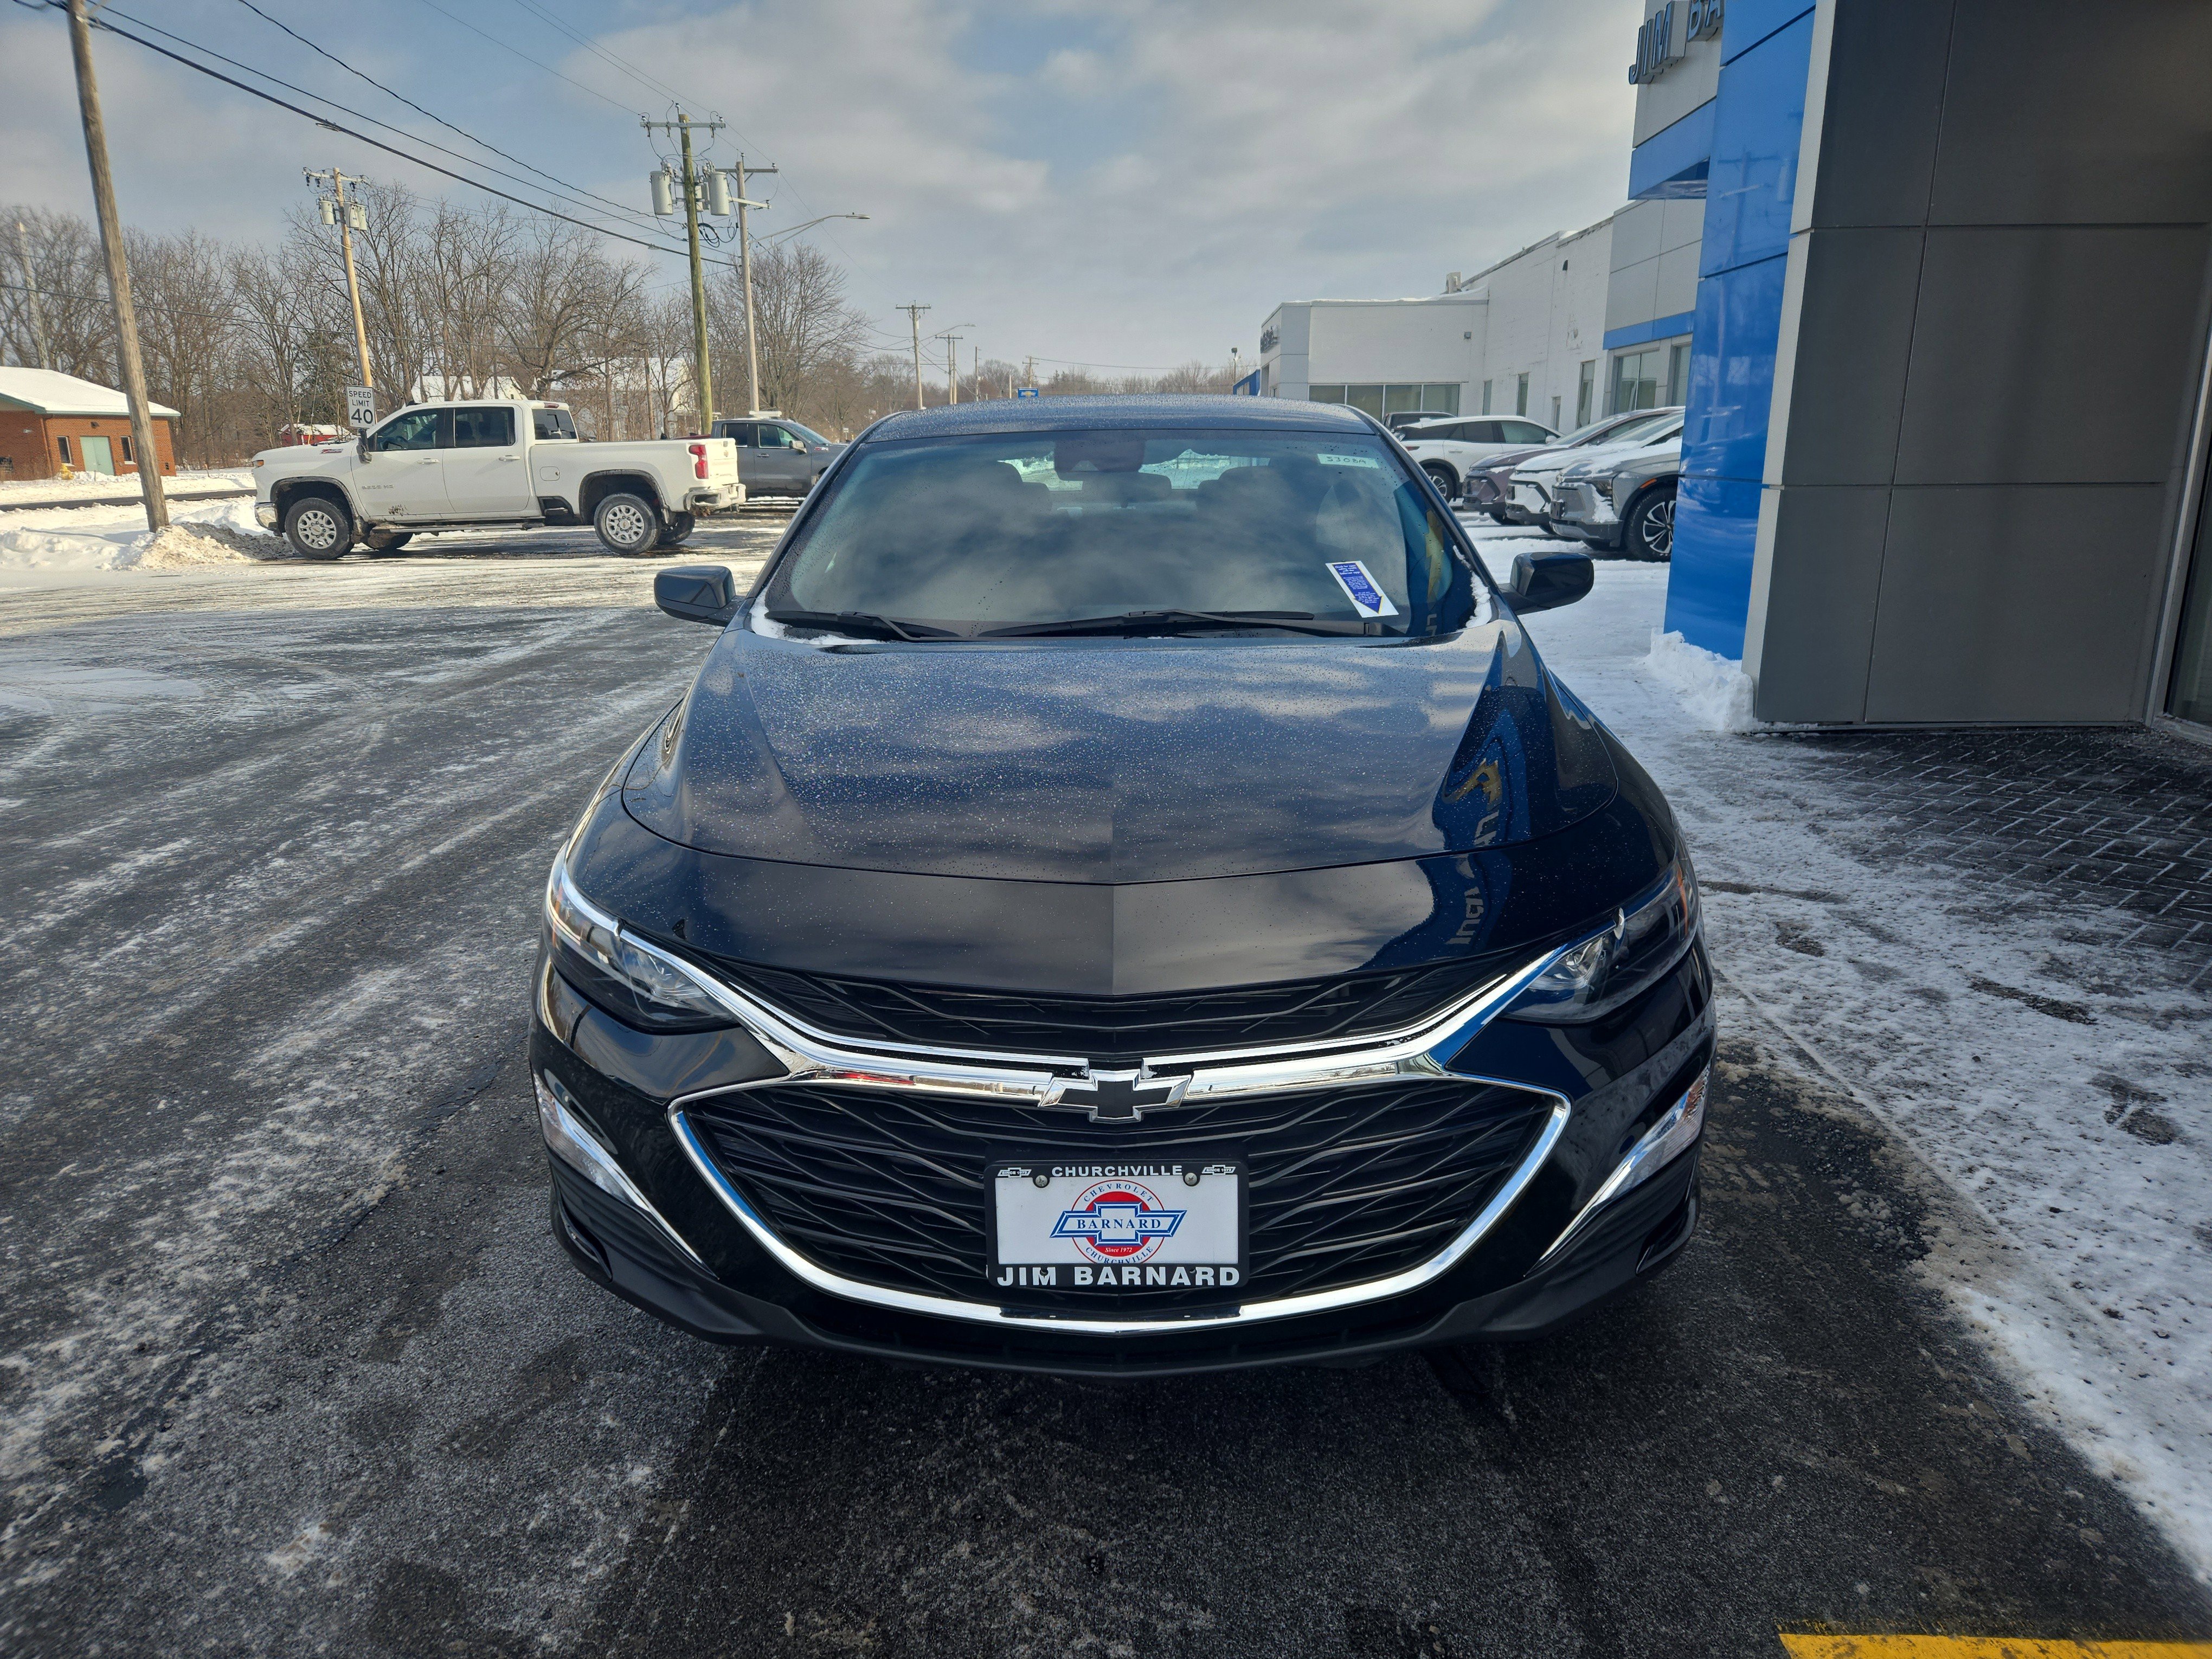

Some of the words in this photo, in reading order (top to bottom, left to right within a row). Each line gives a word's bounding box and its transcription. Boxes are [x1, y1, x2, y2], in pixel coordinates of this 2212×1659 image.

[1629, 0, 1676, 85] JIM
[349, 390, 371, 398] SPEED
[351, 408, 373, 424] 40
[1051, 1165, 1182, 1176] CHURCHVILLE
[1084, 1182, 1154, 1203] CHEVROLET
[1077, 1219, 1161, 1229] BARNARD
[1085, 1246, 1153, 1264] CHURCHVILLE
[996, 1266, 1056, 1286] JIM
[1074, 1266, 1239, 1286] BARNARD
